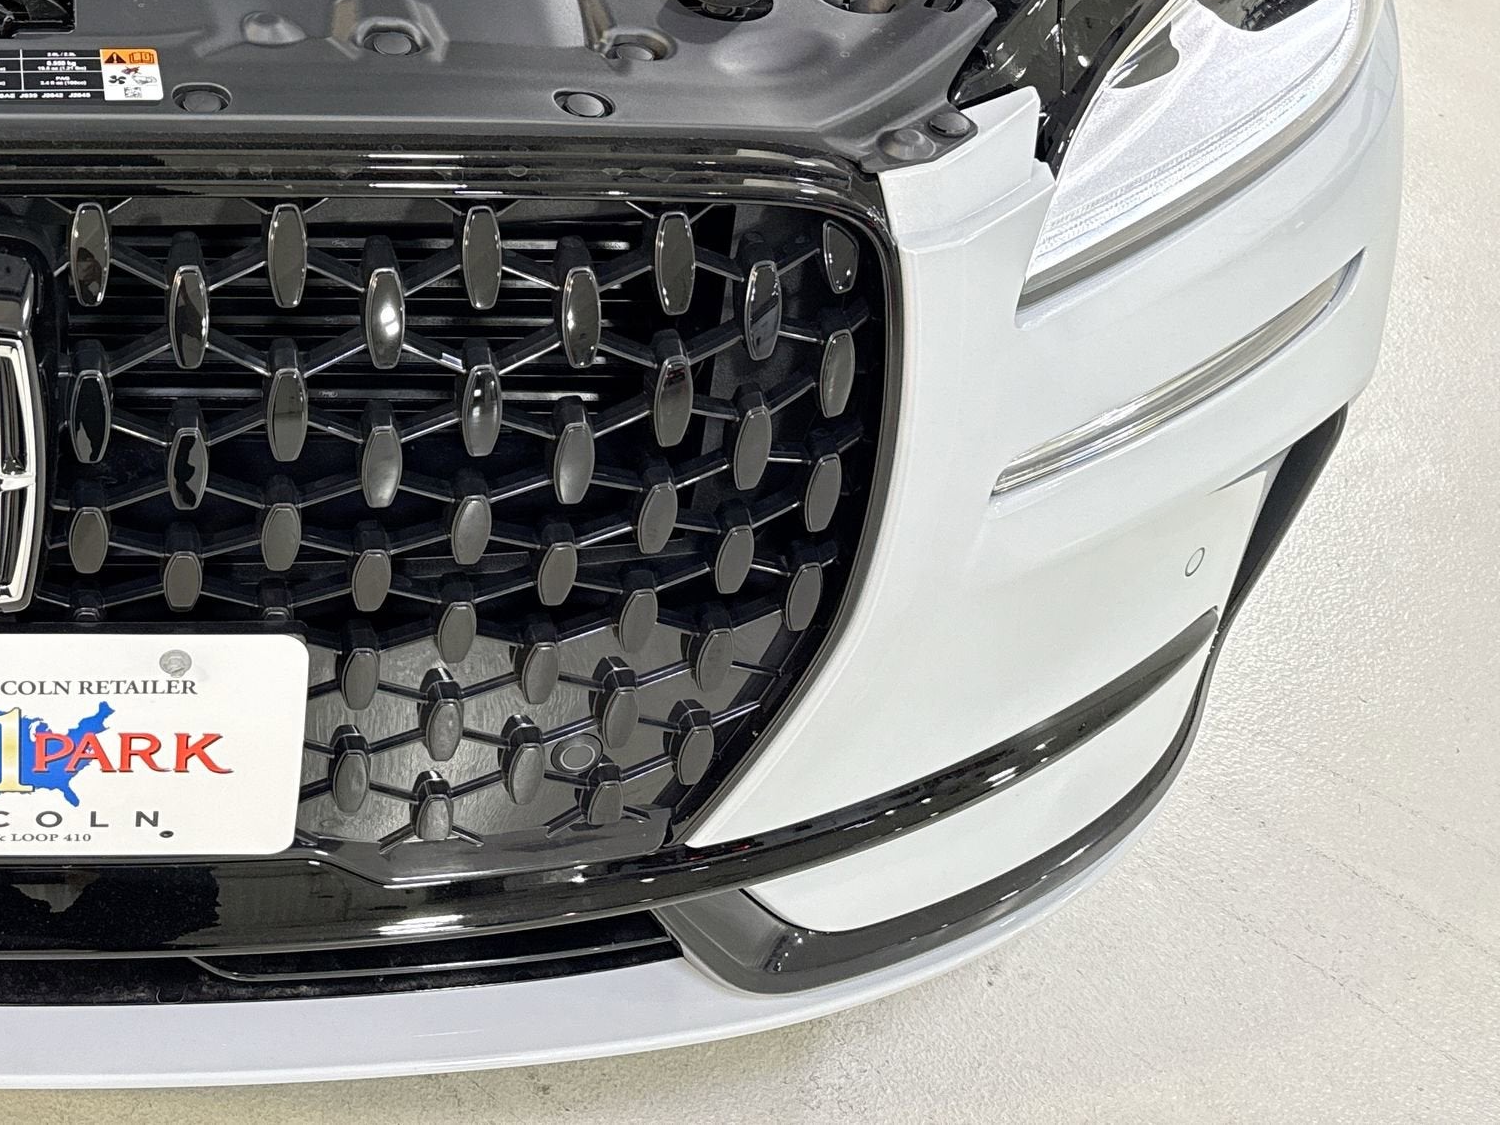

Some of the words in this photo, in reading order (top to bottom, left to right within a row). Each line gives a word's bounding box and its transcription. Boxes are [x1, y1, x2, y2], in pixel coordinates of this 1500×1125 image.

[78, 679, 198, 695] RETAILER
[32, 731, 235, 774] PARK
[11, 832, 62, 843] LOOP
[63, 832, 92, 843] 410
